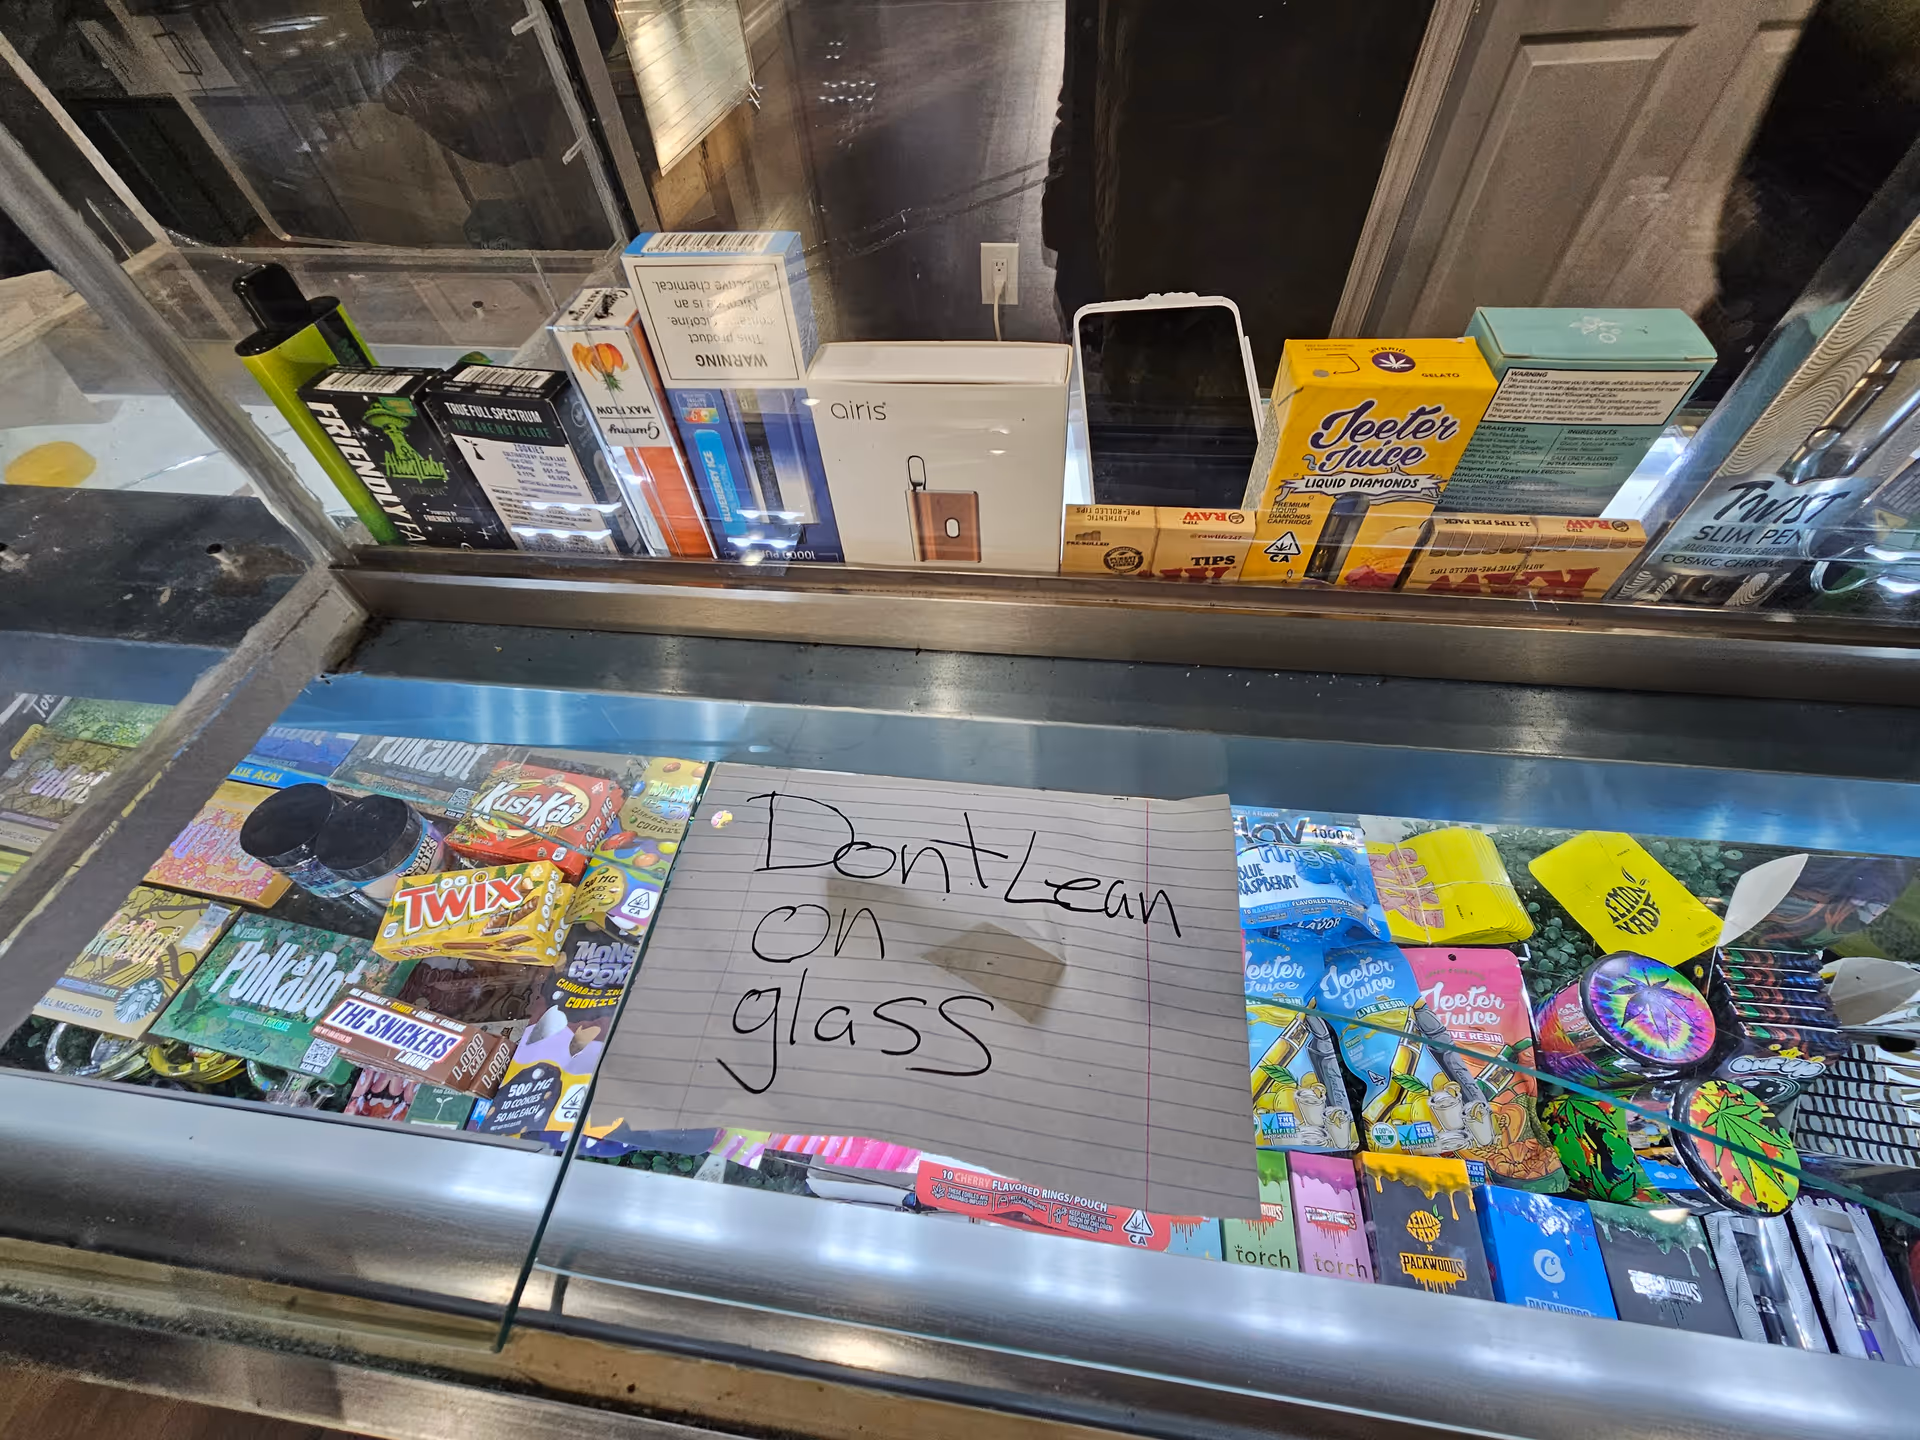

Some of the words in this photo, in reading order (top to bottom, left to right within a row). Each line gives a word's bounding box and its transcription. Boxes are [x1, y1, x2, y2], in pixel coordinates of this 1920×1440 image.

[652, 280, 710, 293] chemical.
[675, 299, 689, 308] an
[693, 299, 703, 308] is
[688, 333, 733, 344] product
[695, 354, 768, 368] WARNING
[444, 402, 471, 416] TRUE
[470, 405, 492, 419] FULL
[491, 407, 542, 423] SPECTRUM
[596, 406, 625, 415] FLOW
[626, 405, 651, 414] MAX
[831, 401, 886, 421] airis
[452, 419, 473, 430] YOU
[475, 421, 495, 434] ARE
[494, 424, 516, 434] NOT
[518, 427, 552, 439] ALONE
[608, 422, 660, 439] Gummy
[1310, 399, 1459, 450] Jeeter
[308, 402, 412, 520] FRIENDLY
[1318, 439, 1427, 473] Juice
[1305, 478, 1346, 489] LIQUID
[1350, 477, 1420, 489] DIAMONDS
[1713, 480, 1851, 524] TWIST
[1087, 514, 1128, 522] AUTHENTIC
[1184, 512, 1227, 522] RAW
[1566, 520, 1612, 530] RAW
[1693, 525, 1755, 545] SLIM
[1756, 529, 1802, 545] PEN
[1191, 555, 1236, 567] TIPS
[1270, 555, 1290, 563] CA
[1661, 554, 1724, 567] COSMIC
[1450, 565, 1497, 574] PRE-ROLLED
[472, 782, 583, 828] KushKat
[1312, 829, 1344, 840] 1000
[1258, 844, 1337, 869] rings
[599, 875, 618, 884] MG
[1238, 863, 1264, 880] BLUE
[440, 875, 468, 890] OG
[1004, 831, 1181, 937] Lean
[1238, 875, 1299, 896] RASPBERRY
[399, 871, 522, 931] TWIX
[1292, 898, 1327, 907] FLAVORED
[629, 908, 640, 916] CA
[1320, 956, 1394, 999] Jeeter
[556, 977, 603, 996] CANNABIS
[1342, 978, 1396, 1009] Juice
[1420, 981, 1505, 1012] Jeeter
[55, 1000, 103, 1018] MACCHIATO
[1357, 1006, 1380, 1019] LIVE
[1381, 1000, 1407, 1012] RESIN
[331, 1001, 377, 1030] THC
[365, 1013, 457, 1060] SNICKERS
[716, 968, 994, 1094] glass
[1469, 1032, 1502, 1043] RESIN
[508, 1082, 532, 1098] 500
[534, 1077, 554, 1091] MG
[501, 1100, 511, 1110] 10
[511, 1093, 542, 1108] COOKIES
[494, 1112, 506, 1123] 50
[506, 1110, 520, 1121] MG
[520, 1105, 540, 1118] EACH
[1400, 1137, 1435, 1145] VERIFIED
[942, 1169, 953, 1180] 10
[954, 1172, 992, 1188] CHERRY
[992, 1180, 1040, 1197] FLAVORED
[1042, 1189, 1108, 1212] RINGS/POUCH
[1090, 1221, 1113, 1232] CHILDREN
[1129, 1235, 1146, 1245] CA
[1236, 1247, 1291, 1269] torch
[1402, 1254, 1465, 1279] PACKWOODS
[1315, 1255, 1368, 1279] torch
